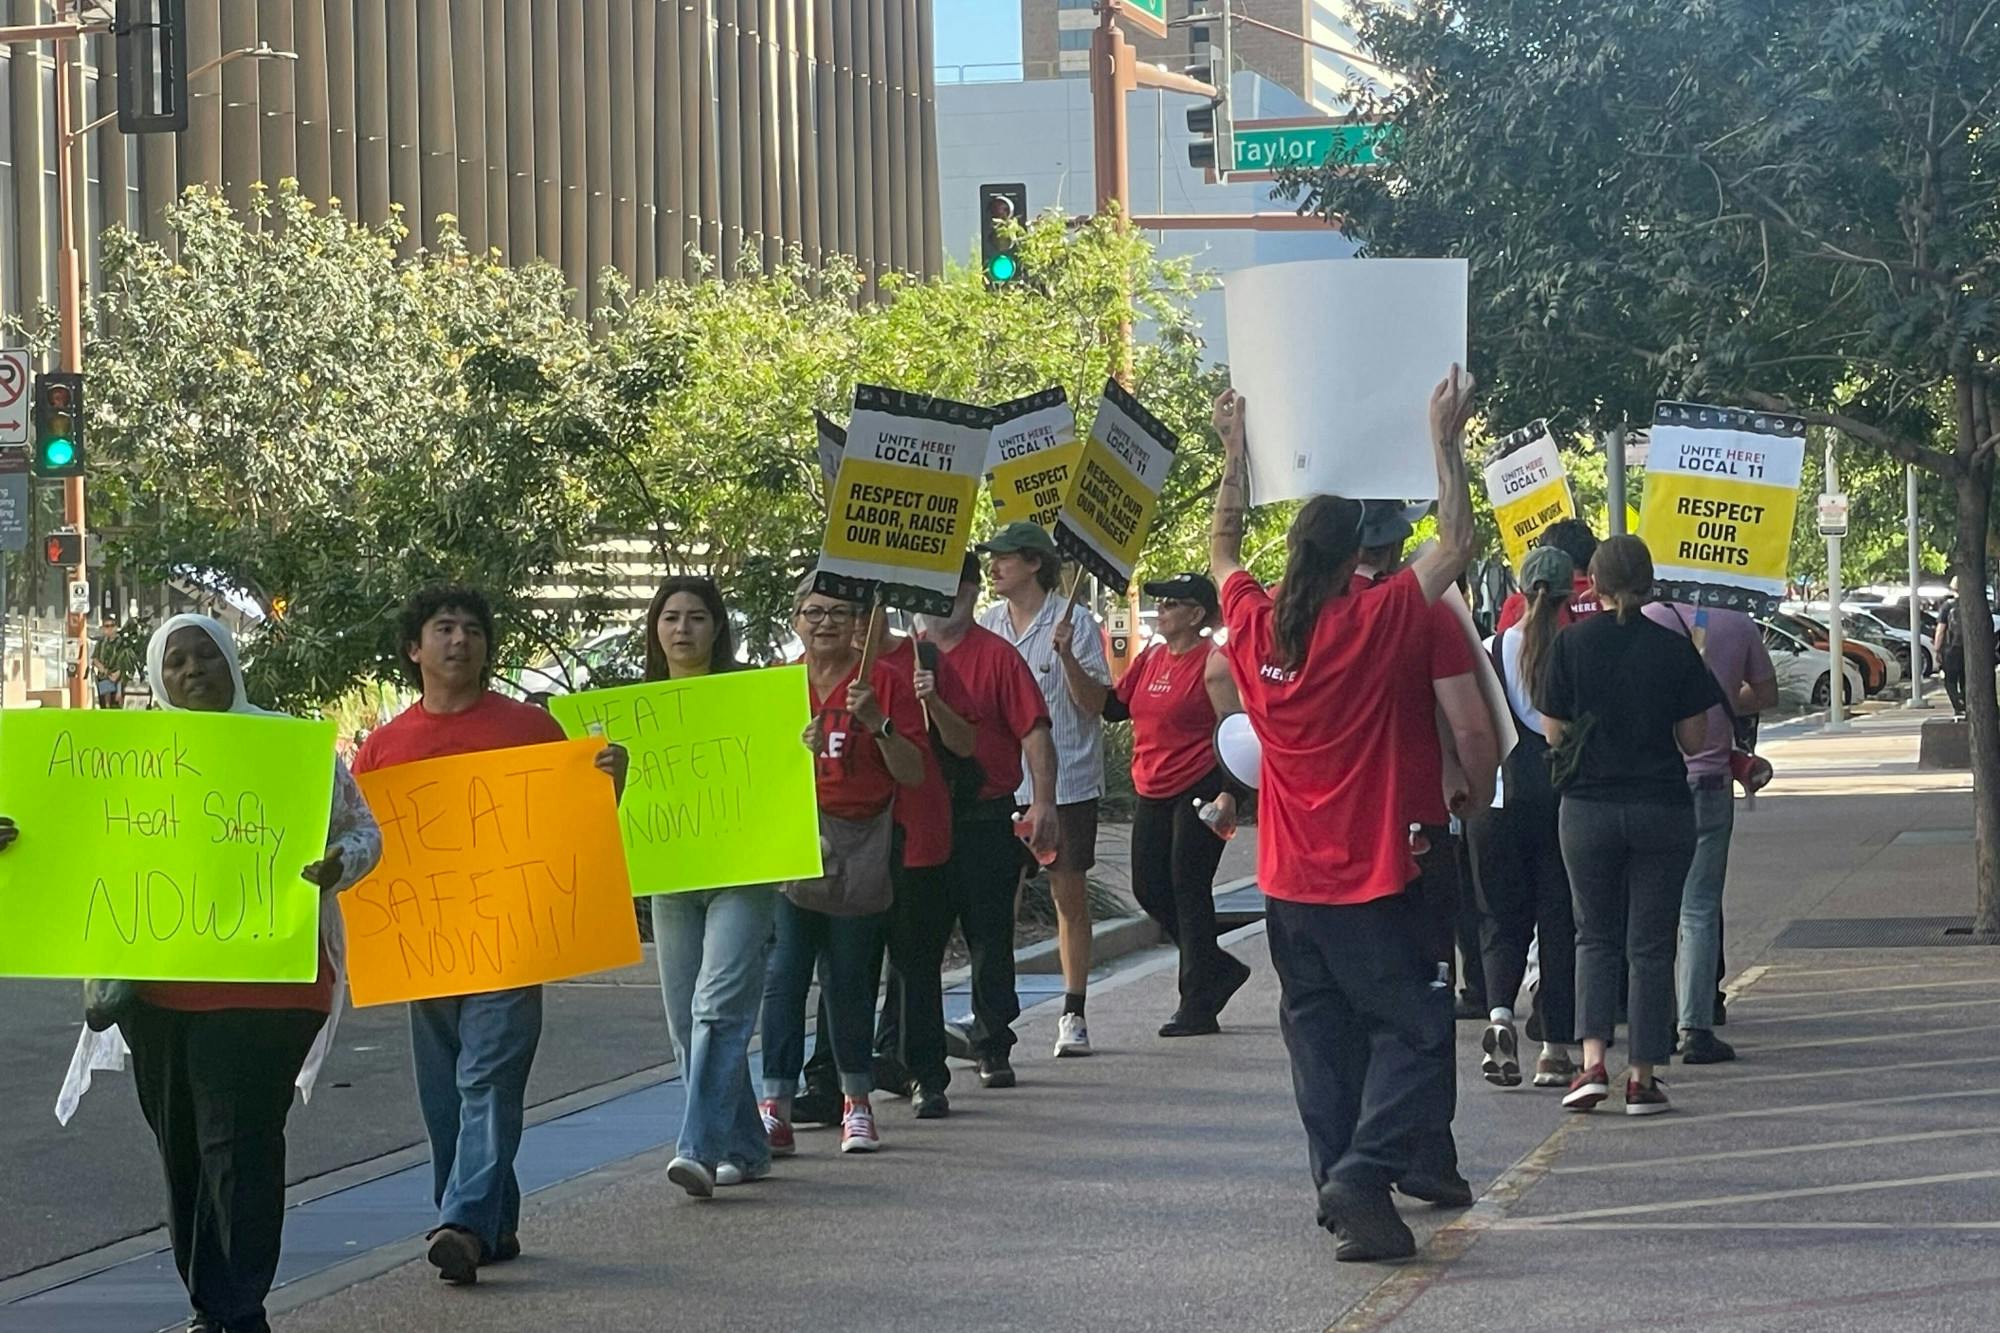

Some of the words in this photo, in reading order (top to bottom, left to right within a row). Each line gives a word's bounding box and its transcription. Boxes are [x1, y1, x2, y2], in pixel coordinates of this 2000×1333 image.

[1233, 137, 1316, 166] Taylor
[879, 432, 918, 449] UNITE
[920, 440, 956, 456] HERE!
[998, 432, 1026, 449] UNITE
[1001, 439, 1041, 461] LOCAL
[1044, 435, 1056, 448] 11
[1107, 431, 1134, 465] LOCAL
[1136, 460, 1147, 476] 11
[1681, 444, 1722, 459] UNITE
[1726, 449, 1765, 463] HERE!
[875, 444, 929, 468] LOCAL
[939, 456, 953, 471] 11
[1679, 455, 1738, 475] LOCAL
[1748, 464, 1764, 478] 11
[1014, 464, 1069, 495] RESPECT
[1087, 458, 1124, 500] RESPECT
[1122, 494, 1144, 519] OUR
[1501, 466, 1525, 483] UNITE
[1504, 471, 1538, 495] LOCAL
[1539, 466, 1549, 480] 11
[850, 483, 925, 509] RESPECT
[926, 495, 959, 514] OUR
[1034, 487, 1061, 508] OUR
[1677, 496, 1765, 524] RESPECT
[845, 503, 905, 532] LABOR,
[908, 513, 956, 535] RAISE
[1076, 493, 1097, 519] OUR
[1096, 511, 1129, 548] WAGES!
[1110, 503, 1139, 535] RAISE
[1514, 516, 1540, 537] WILL
[1537, 500, 1563, 525] WORK
[1697, 521, 1737, 543] OUR
[846, 525, 882, 546] OUR
[885, 530, 947, 555] WAGES!
[1678, 540, 1749, 566] RIGHTS
[1260, 664, 1297, 682] HEE
[575, 687, 692, 743] HEAT
[48, 730, 202, 778] Aramark
[104, 793, 181, 839] Heat
[203, 790, 286, 864] Safety
[362, 767, 554, 866] HEAT
[355, 852, 578, 938] SAFETY
